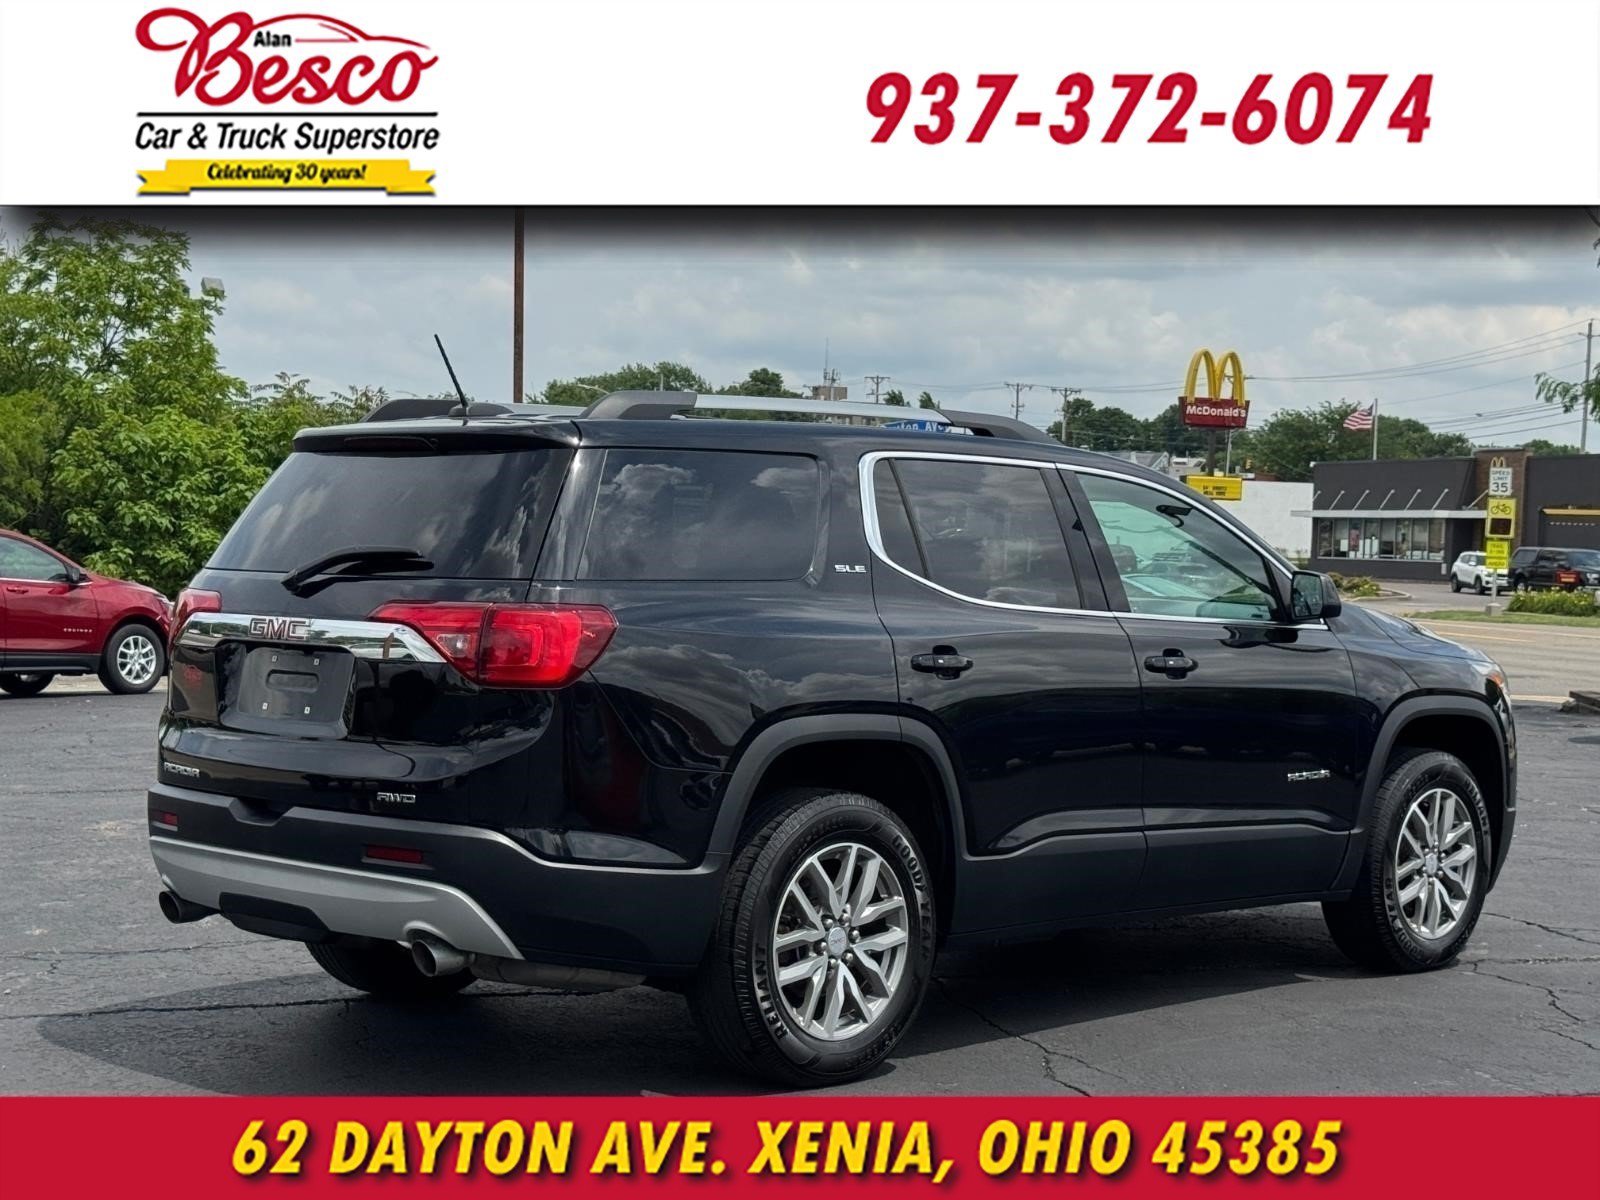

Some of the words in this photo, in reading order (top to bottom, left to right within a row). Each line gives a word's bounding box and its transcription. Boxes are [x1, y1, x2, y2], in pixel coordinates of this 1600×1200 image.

[1186, 405, 1247, 418] McDonald's
[1491, 482, 1509, 493] 35
[834, 564, 867, 573] SLE
[249, 617, 311, 640] GMC
[376, 791, 416, 804] AWD
